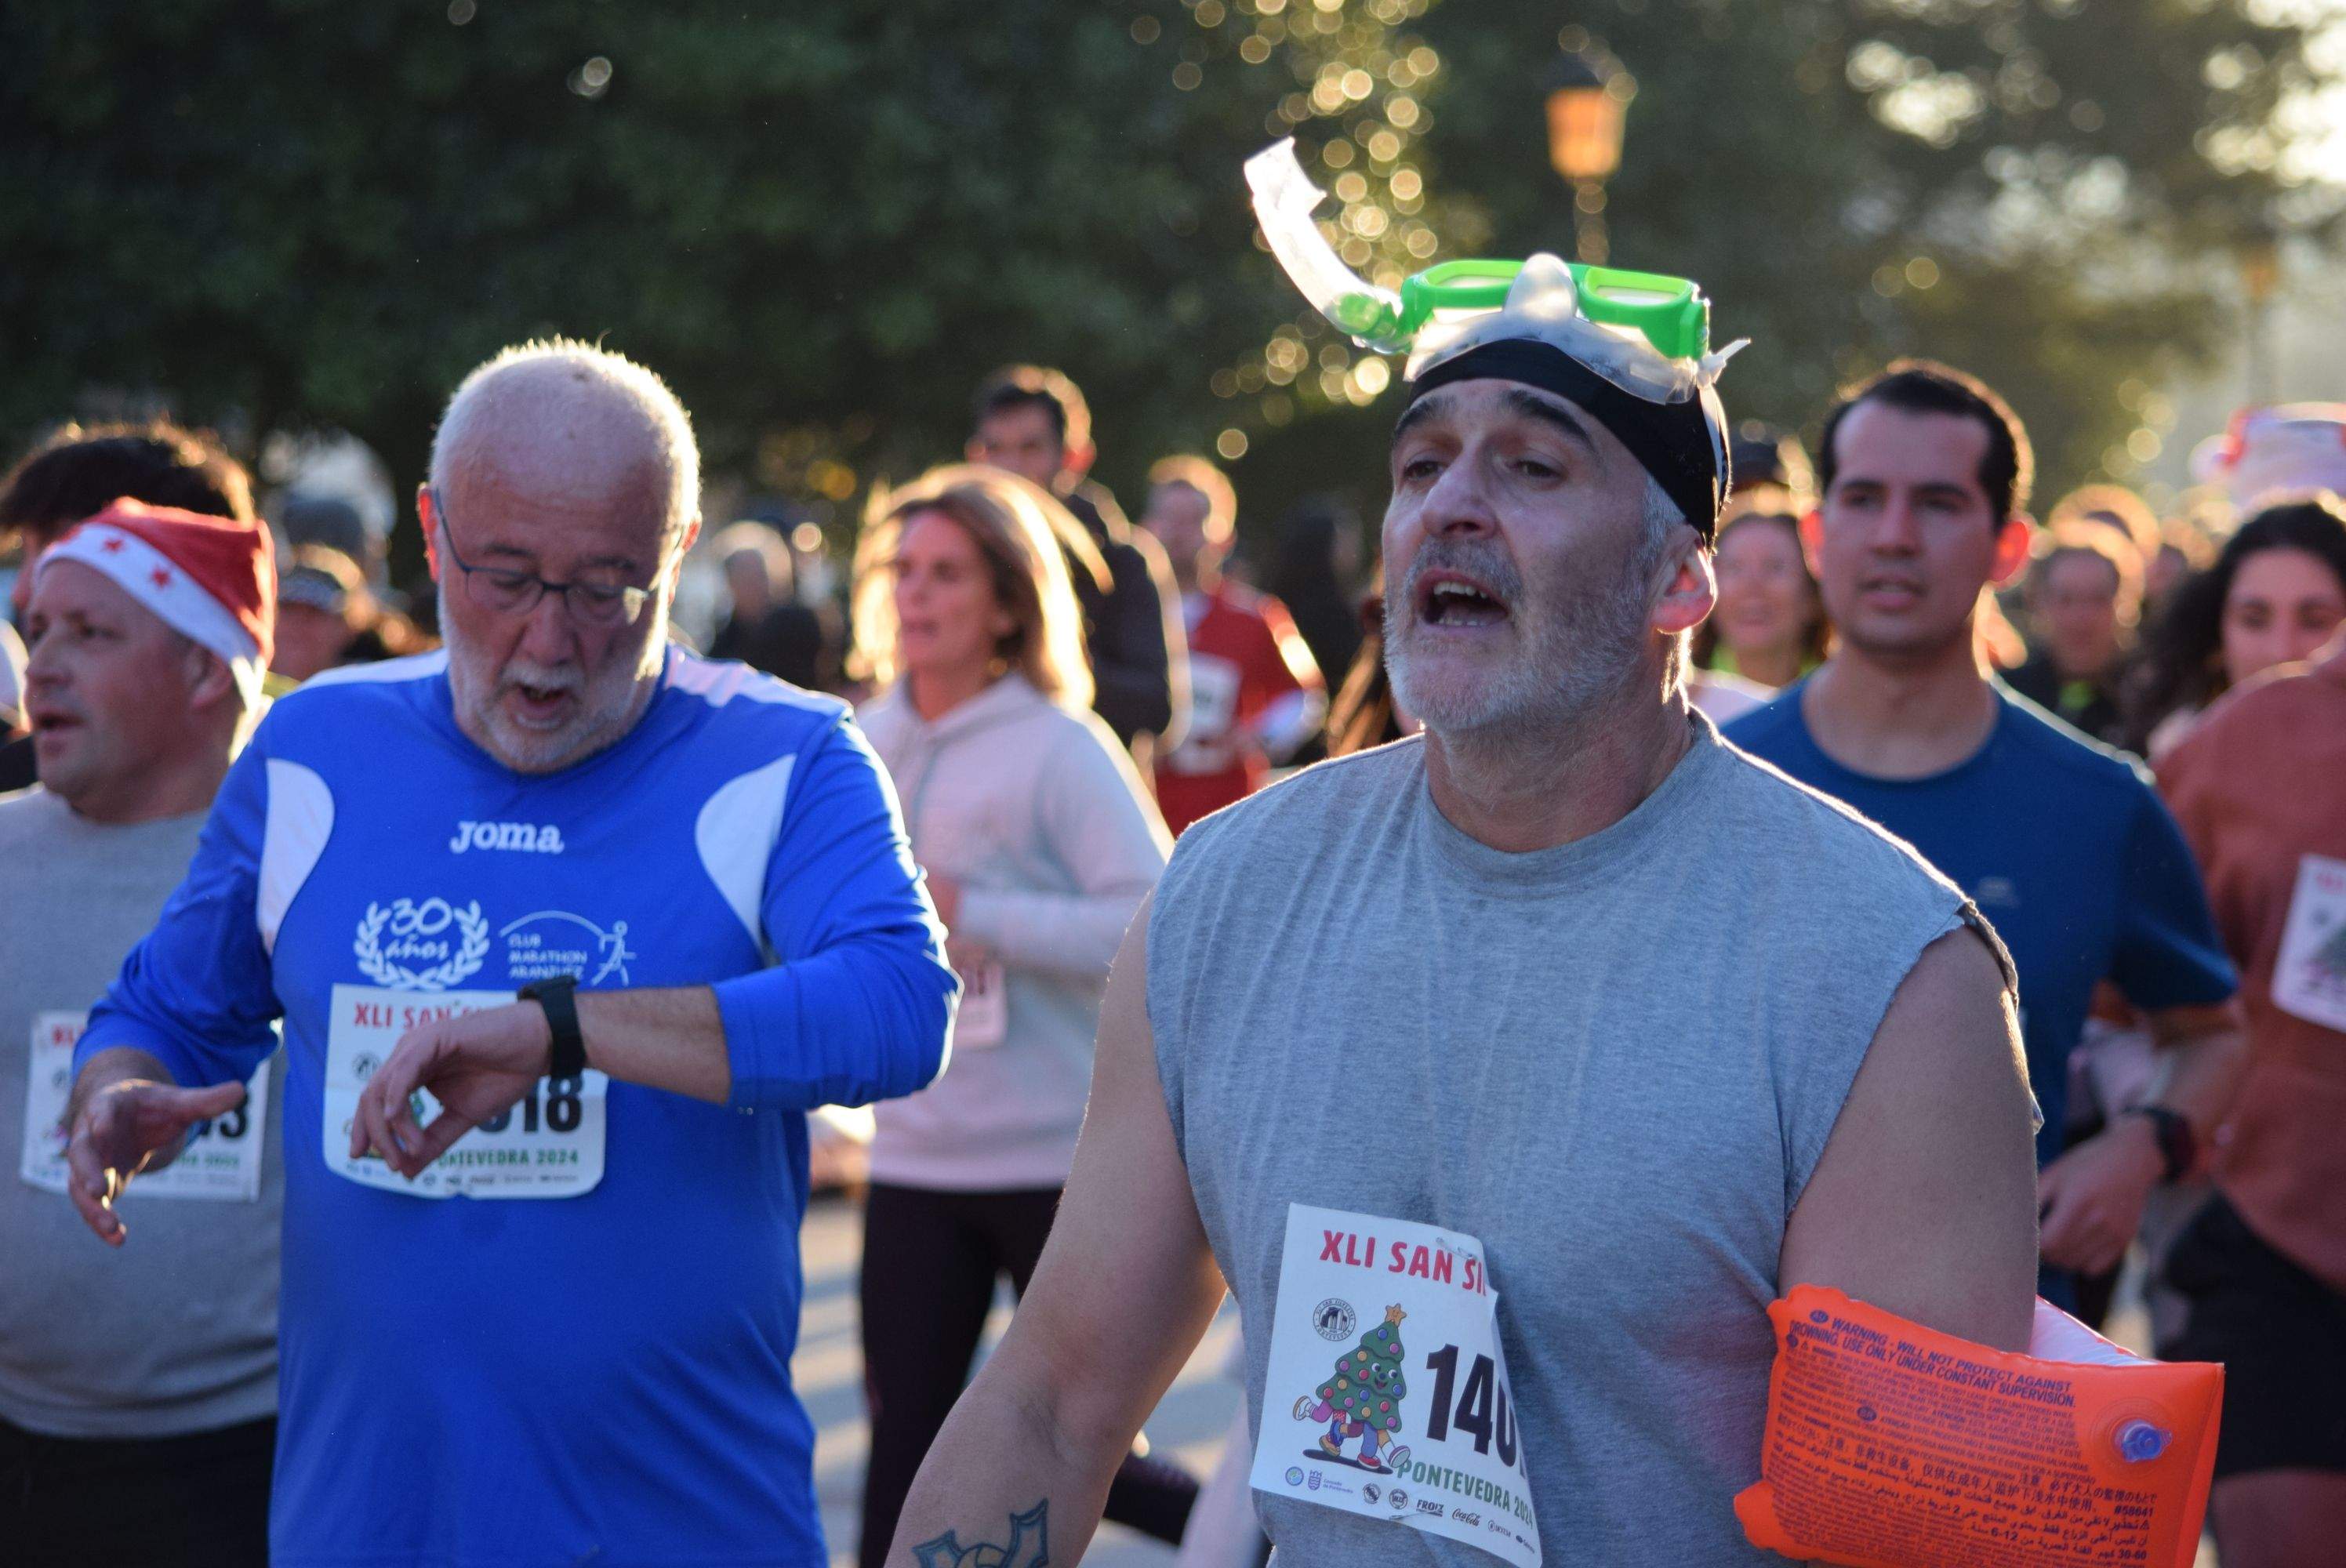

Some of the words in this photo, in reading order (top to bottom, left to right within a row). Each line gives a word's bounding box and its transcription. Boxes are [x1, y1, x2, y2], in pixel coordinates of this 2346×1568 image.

[390, 897, 452, 936] 30
[385, 933, 449, 961] años
[508, 933, 542, 949] CLUB
[508, 949, 587, 964] MARATHON
[355, 1001, 393, 1028] XLI
[438, 1149, 530, 1168] ONTEVEDRA
[537, 1149, 579, 1166] 2024
[1319, 1229, 1376, 1269] XLI
[1388, 1241, 1454, 1284] SAN
[1832, 1317, 1889, 1345] WARNING
[1896, 1340, 1923, 1359] WILL
[1927, 1351, 1953, 1367] NOT
[1956, 1359, 2014, 1381] PROTECT
[2016, 1374, 2072, 1392] AGAINST
[1842, 1337, 1863, 1353] USE
[1865, 1343, 1897, 1363] ONLY
[1896, 1353, 1935, 1375] UNDER
[1936, 1365, 1997, 1390] CONSTANT
[1999, 1382, 2076, 1408] SUPERVISION.
[1425, 1343, 1528, 1481] 140
[1397, 1459, 1510, 1512] PONTEVEDRA
[1513, 1496, 1534, 1530] 2024
[1416, 1499, 1444, 1514] FROIZ
[2114, 1505, 2154, 1517] #58641
[1991, 1528, 2018, 1541] 6-12
[2119, 1550, 2147, 1560] 30-60
